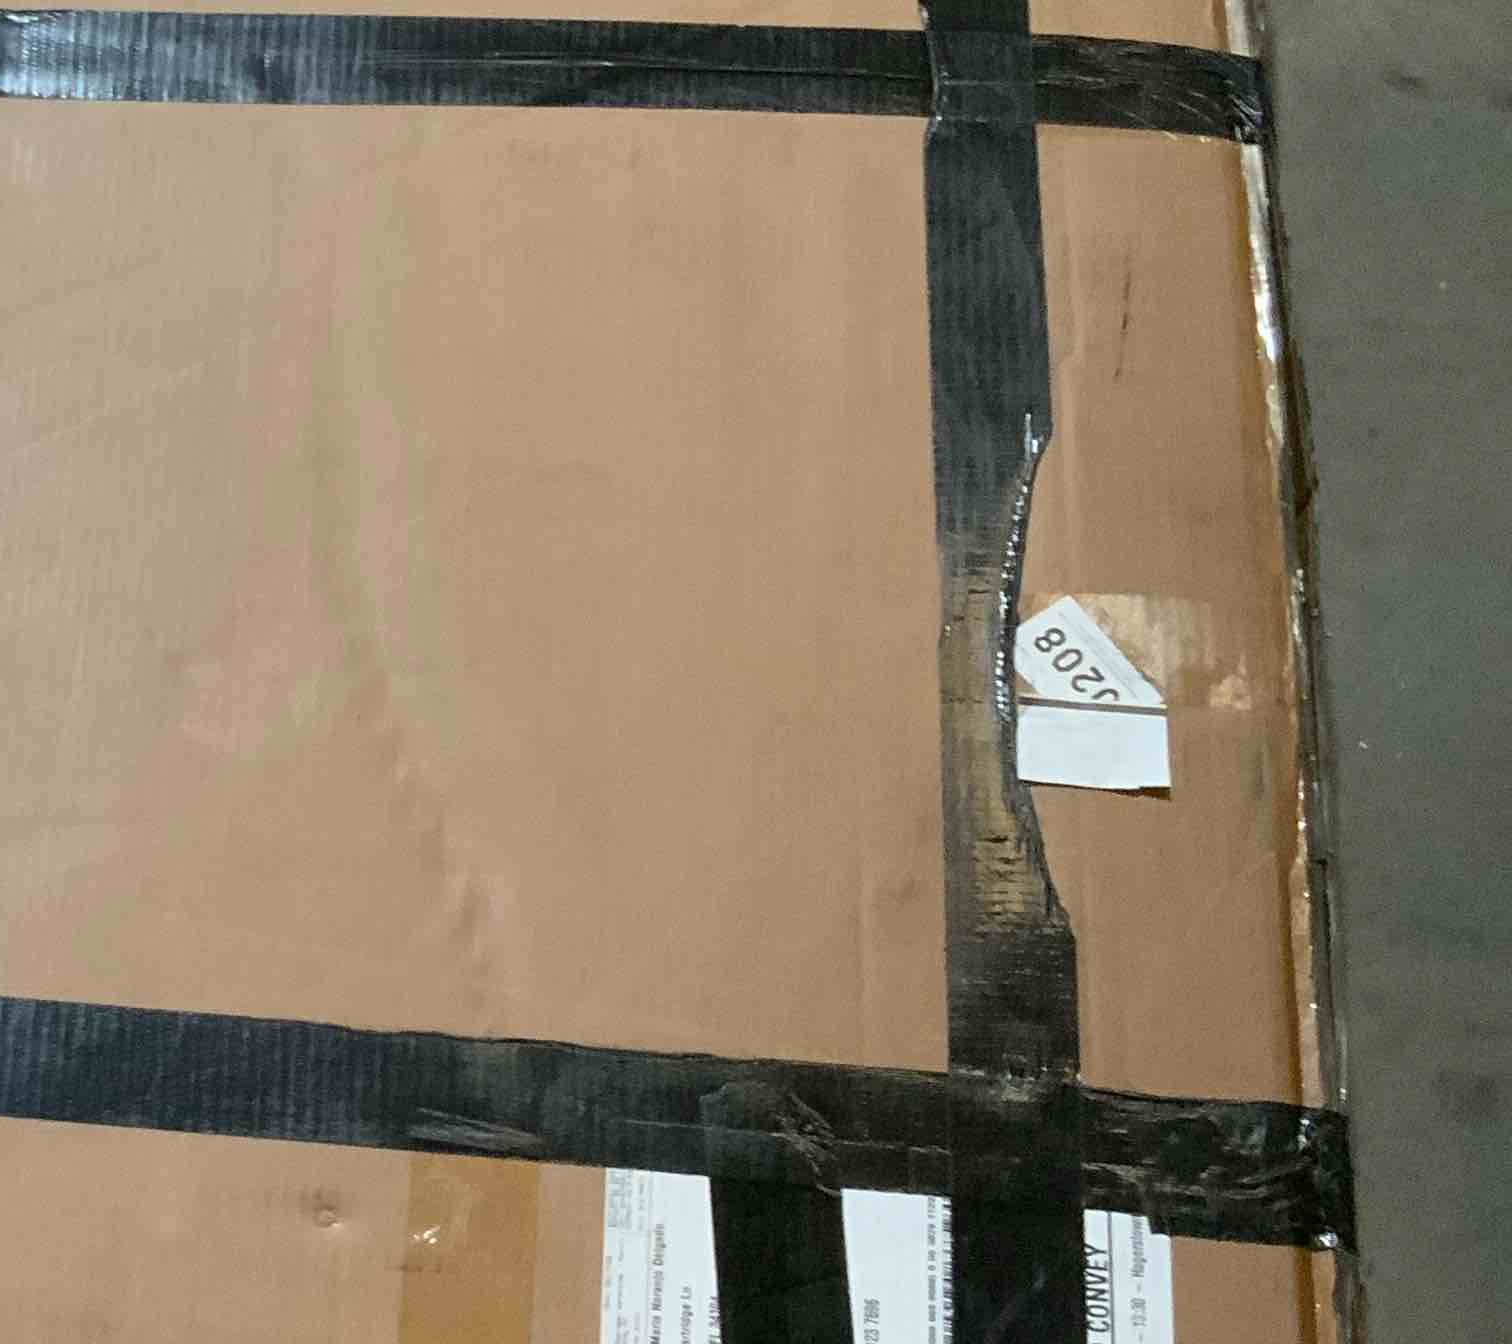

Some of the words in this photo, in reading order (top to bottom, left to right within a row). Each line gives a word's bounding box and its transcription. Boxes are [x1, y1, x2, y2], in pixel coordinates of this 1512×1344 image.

[651, 1270, 665, 1311] Naranjo
[1085, 1242, 1110, 1332] CONVEY
[650, 1316, 662, 1344] Maria
